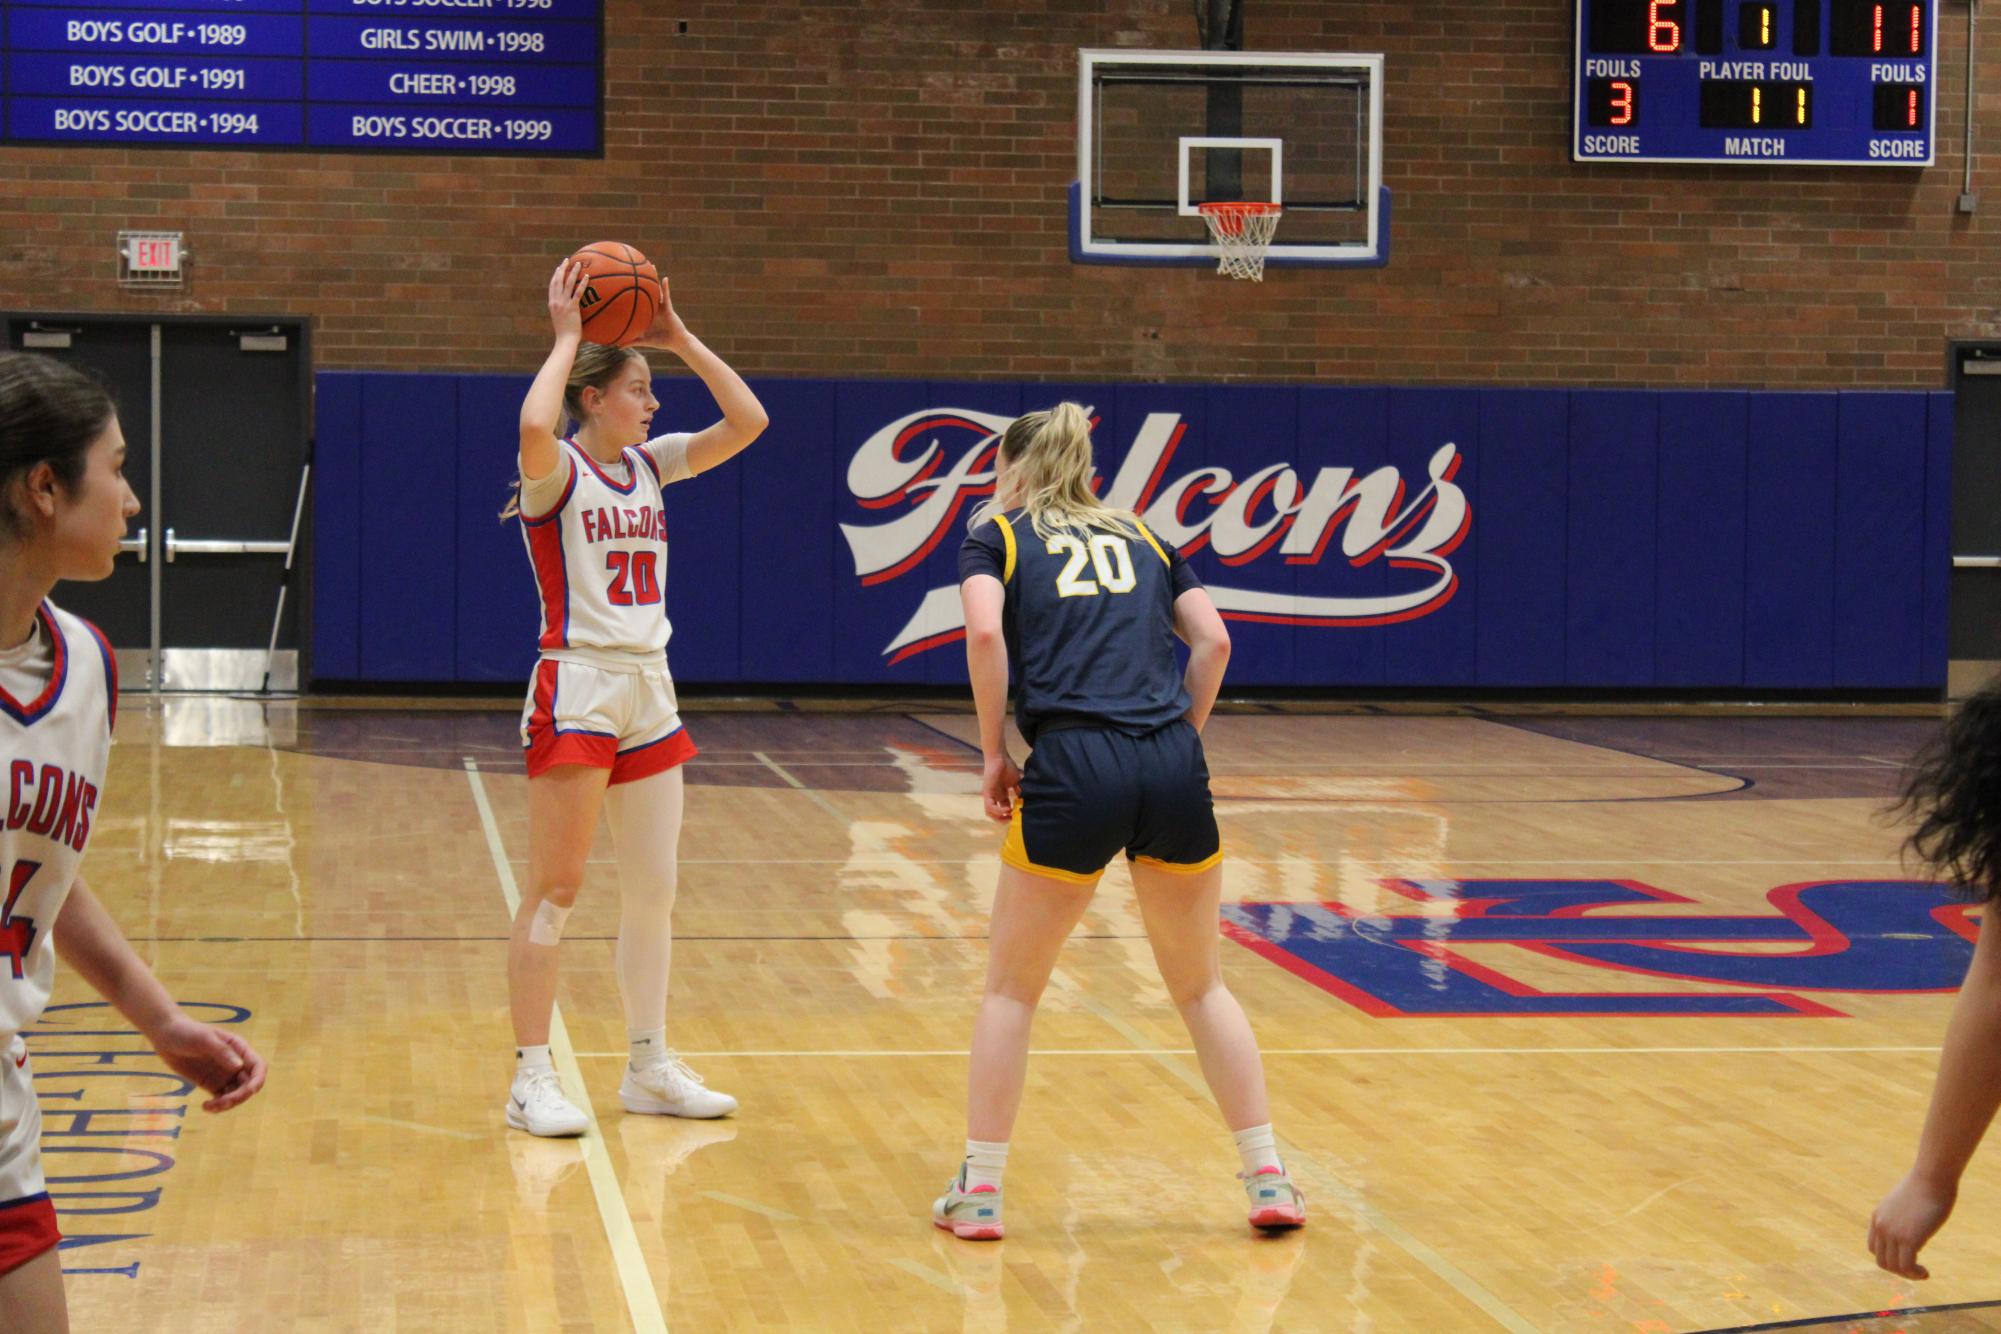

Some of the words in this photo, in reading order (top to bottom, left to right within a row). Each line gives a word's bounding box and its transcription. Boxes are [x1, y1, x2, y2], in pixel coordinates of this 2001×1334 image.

[67, 21, 123, 41] BOYS
[360, 28, 420, 50] GIRLS
[70, 65, 125, 86] BOYS
[1586, 60, 1641, 78] FOULS
[1700, 62, 1765, 80] PLAYER
[1770, 63, 1813, 81] FOUL
[1871, 64, 1926, 82] FOULS
[1611, 82, 1632, 124] 3
[55, 109, 110, 130] BOYS
[353, 116, 407, 137] BOYS
[1584, 136, 1641, 155] SCORE
[1724, 138, 1785, 156] MATCH
[1869, 140, 1925, 158] SCORE
[138, 241, 171, 267] EXIT
[838, 406, 1472, 666] Flcons
[1045, 534, 1137, 598] 20
[606, 551, 662, 607] 20
[0, 760, 98, 852] CONS
